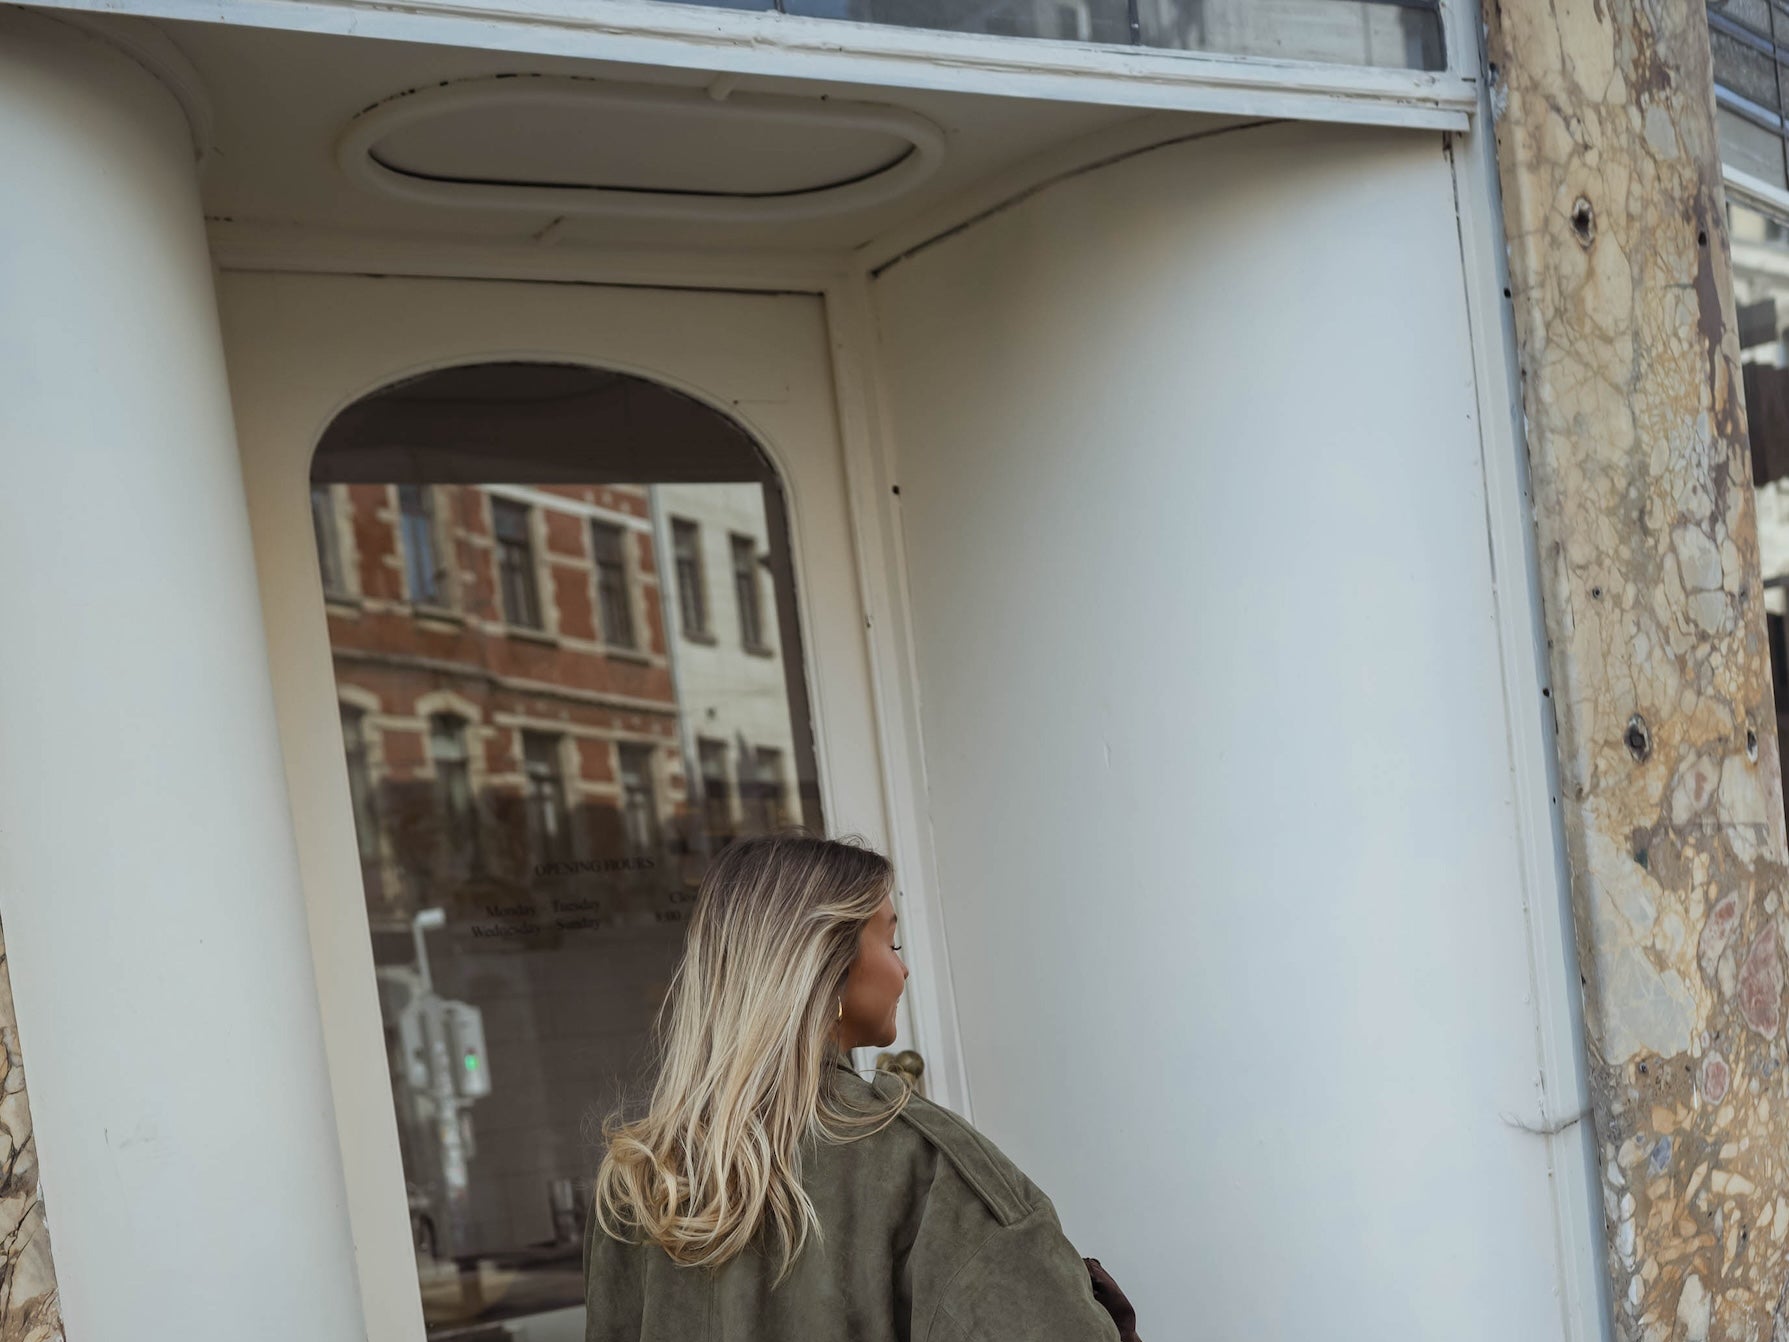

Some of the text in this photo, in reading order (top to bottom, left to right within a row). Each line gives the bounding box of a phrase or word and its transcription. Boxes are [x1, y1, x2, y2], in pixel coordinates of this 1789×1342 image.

[535, 857, 655, 877] OPENING HOURS
[486, 904, 536, 918] Monday
[553, 898, 599, 913] Tuesday
[472, 922, 540, 937] Wednesday
[556, 917, 600, 930] Sunday
